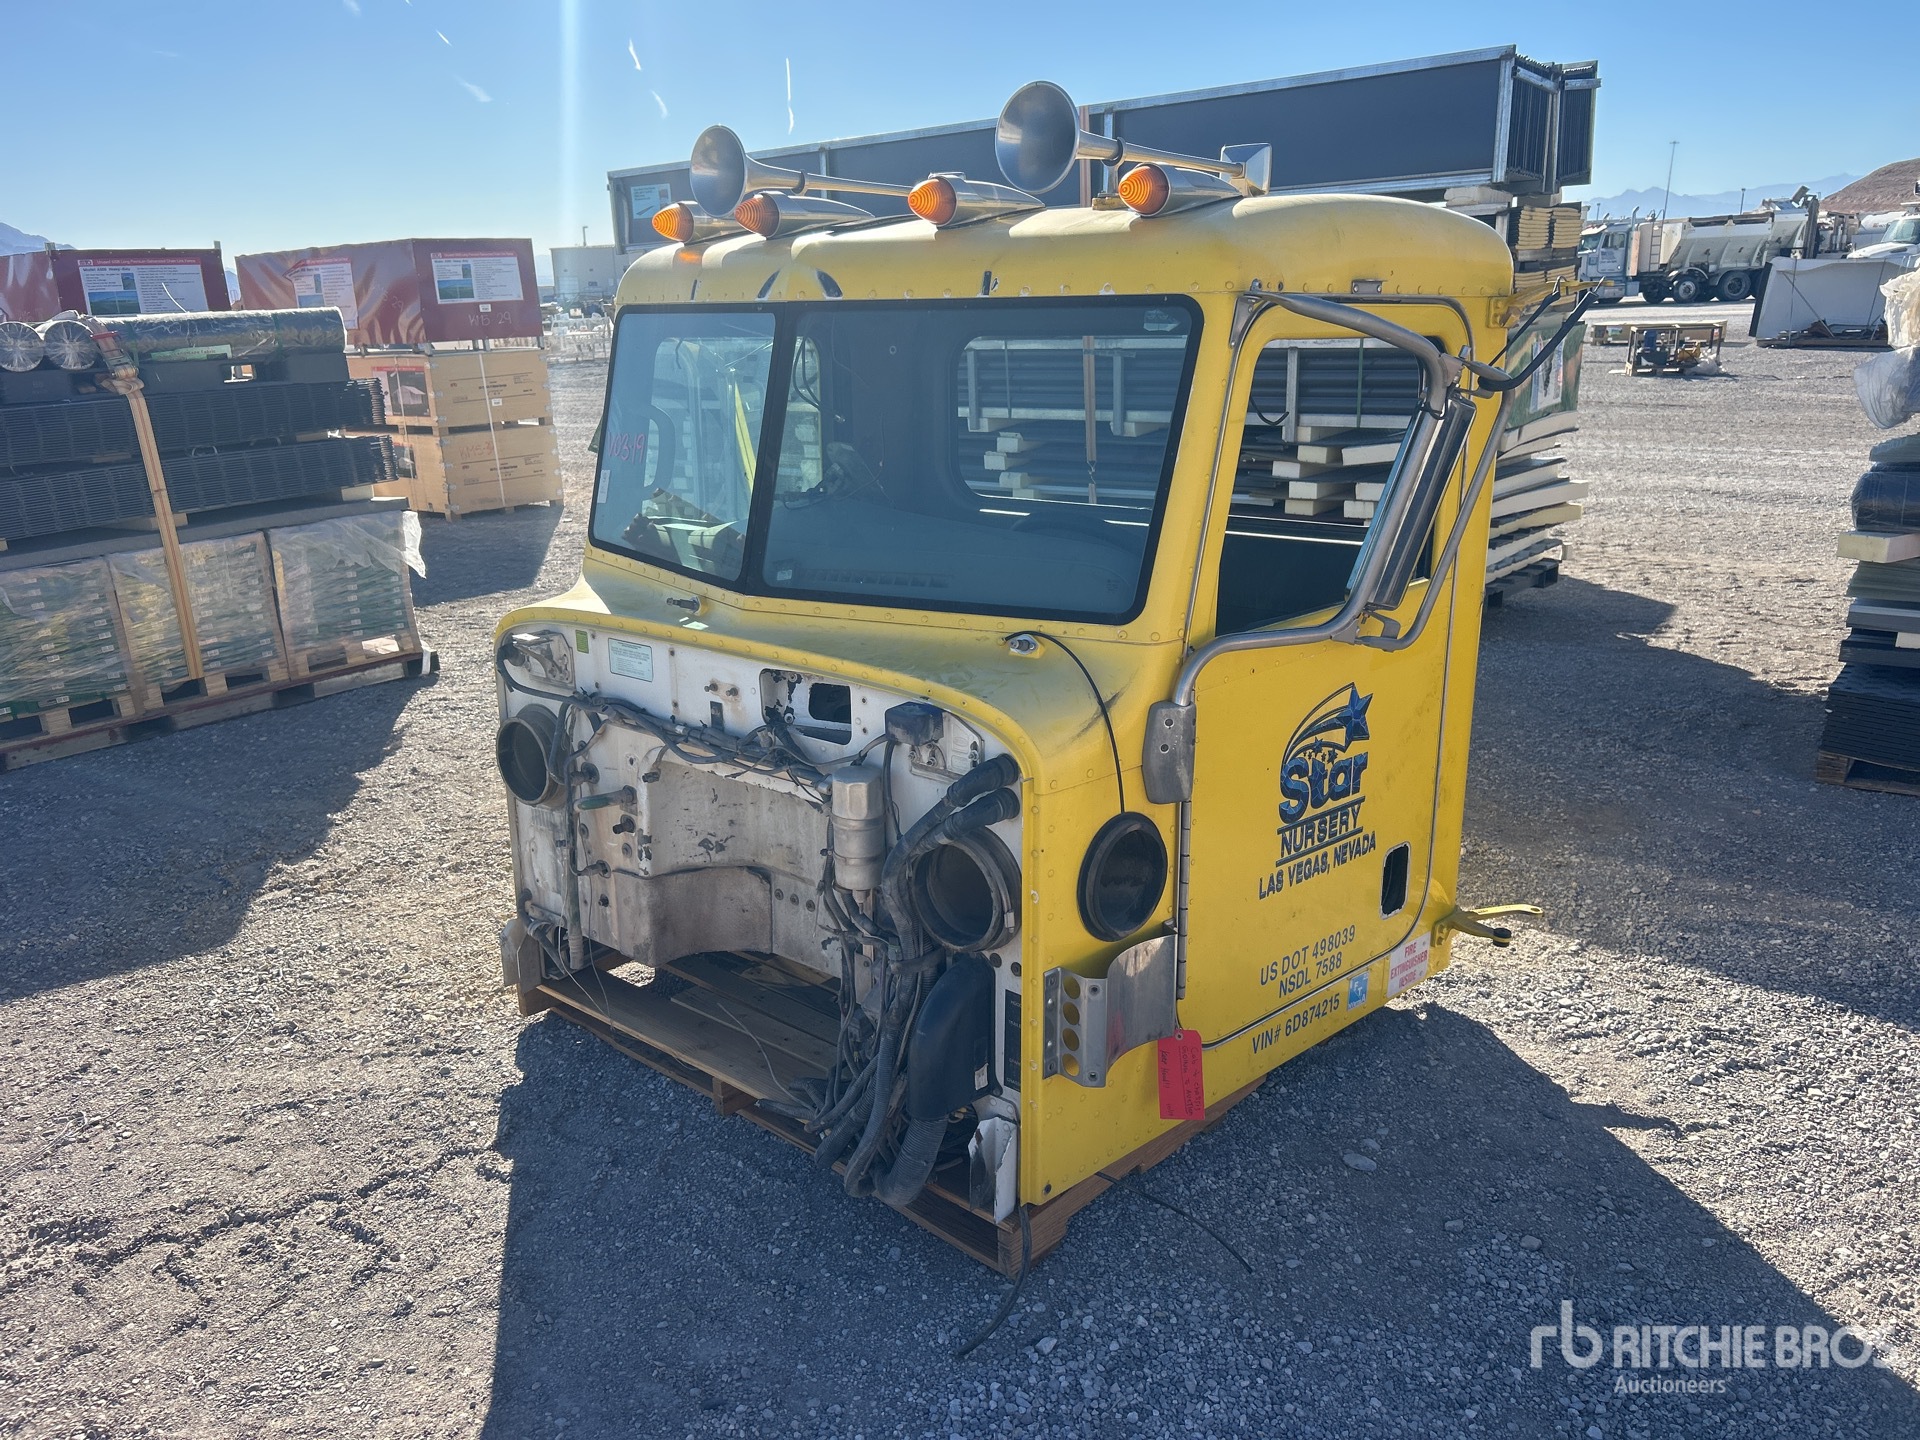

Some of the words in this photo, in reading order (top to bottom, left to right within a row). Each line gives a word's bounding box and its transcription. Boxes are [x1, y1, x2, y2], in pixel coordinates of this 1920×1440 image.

[1279, 752, 1368, 824] Star
[1280, 803, 1362, 858] NURSERY
[1258, 869, 1284, 900] LAS
[1288, 850, 1331, 887] VEGAS,
[1333, 830, 1376, 869] NEVADA
[1260, 961, 1278, 986] US
[1281, 945, 1309, 976] DOT
[1312, 924, 1356, 960] 498039
[1278, 966, 1312, 999] NSDL
[1315, 951, 1343, 980] 7588
[1404, 942, 1417, 958] FIRE
[1252, 1023, 1282, 1055] VIN#
[1284, 992, 1340, 1037] 6D874215
